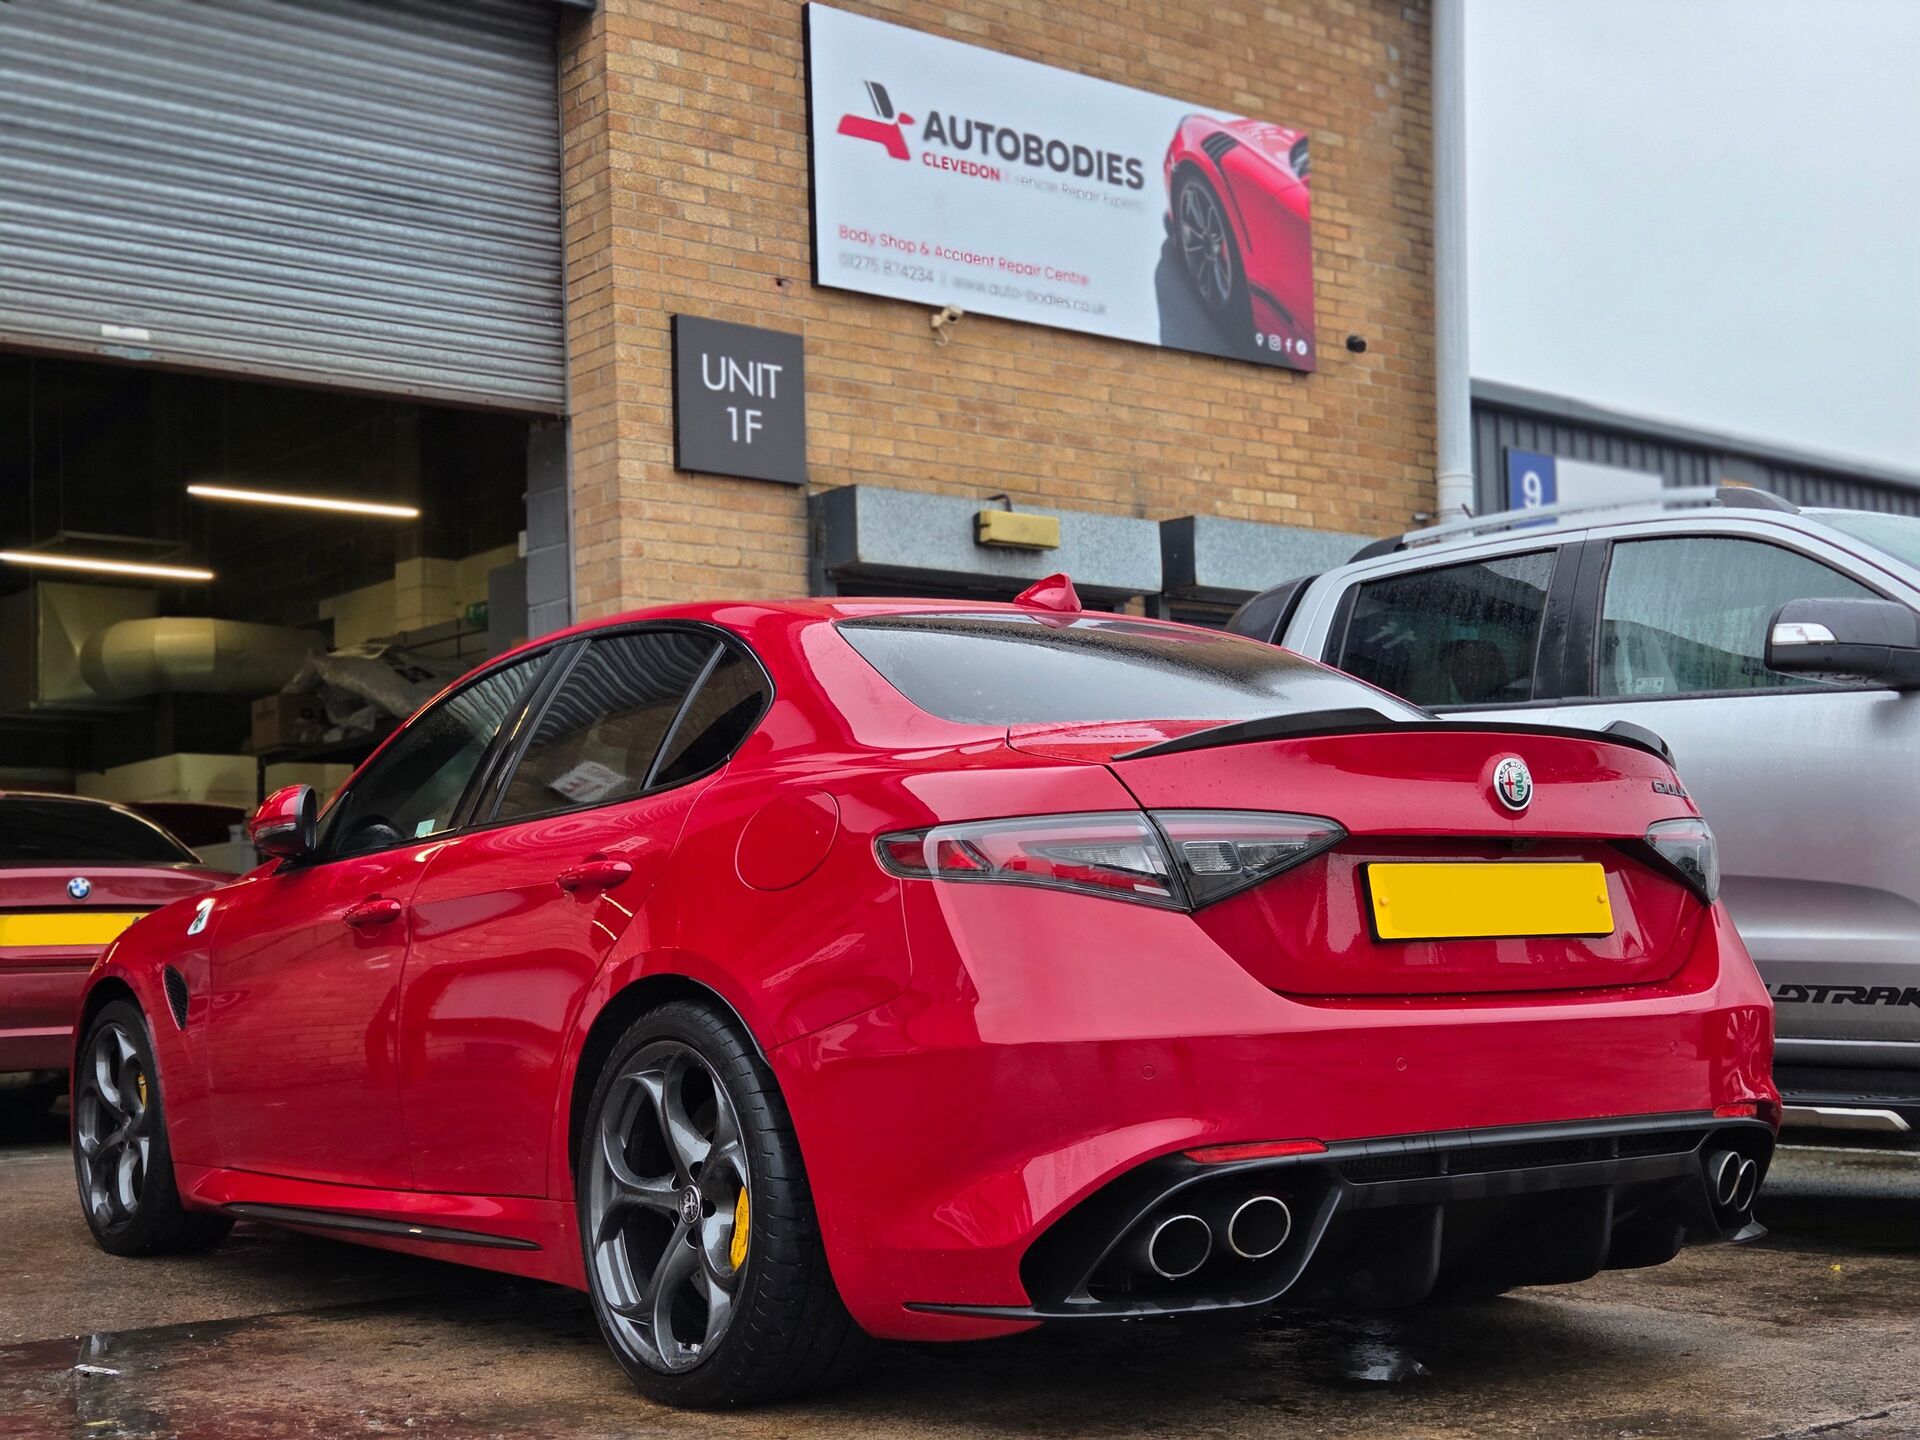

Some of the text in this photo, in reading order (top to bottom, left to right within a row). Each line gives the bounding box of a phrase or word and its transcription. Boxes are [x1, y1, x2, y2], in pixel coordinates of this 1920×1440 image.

[922, 151, 1001, 182] CLEVEDON
[923, 110, 1145, 190] AUTOBODIES
[839, 224, 1090, 287] Body Shop & Accident Repair Centre
[883, 260, 934, 283] 874234
[702, 353, 782, 399] UNIT
[726, 406, 763, 443] 1F
[1522, 470, 1543, 508] 9
